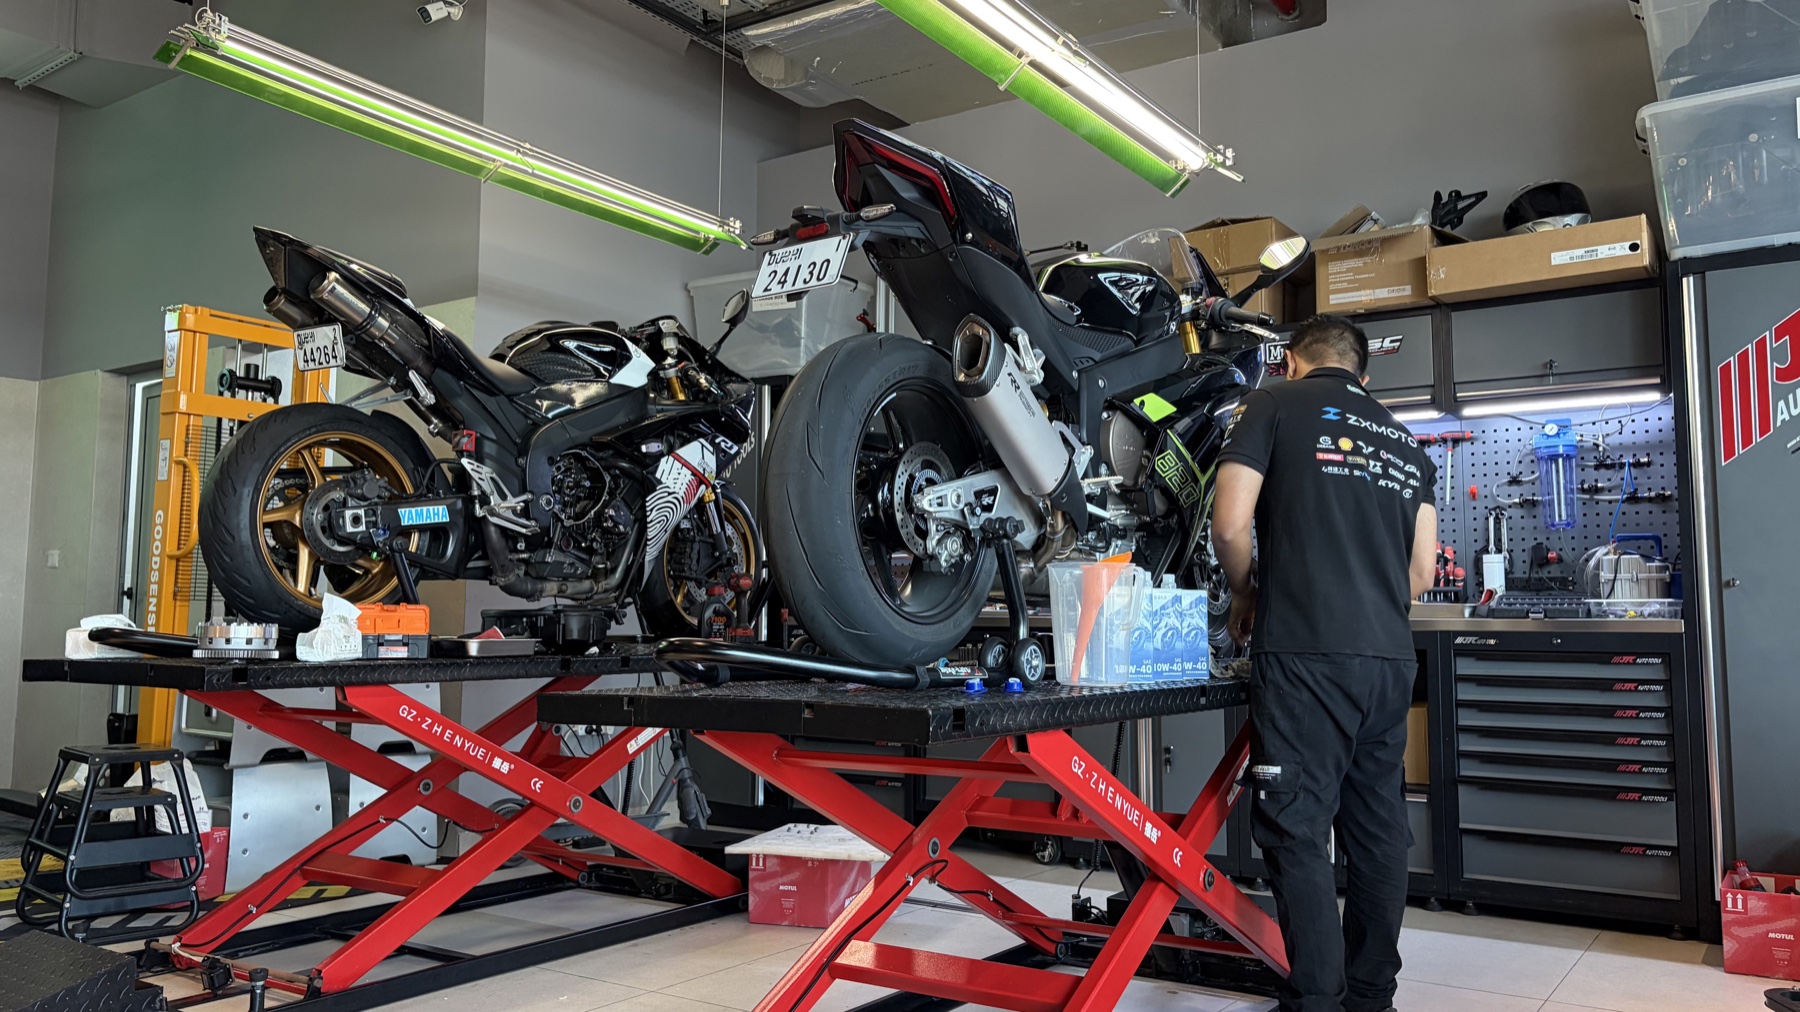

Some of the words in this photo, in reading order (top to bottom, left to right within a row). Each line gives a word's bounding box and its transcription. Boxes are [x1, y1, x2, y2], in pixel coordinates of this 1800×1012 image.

[763, 258, 831, 293] 24130
[303, 345, 338, 368] 44264
[1345, 413, 1418, 448] ZXMOTO
[399, 505, 450, 525] YAMAHA
[1153, 662, 1182, 672] 10W-40
[1768, 932, 1795, 940] MOTUL
